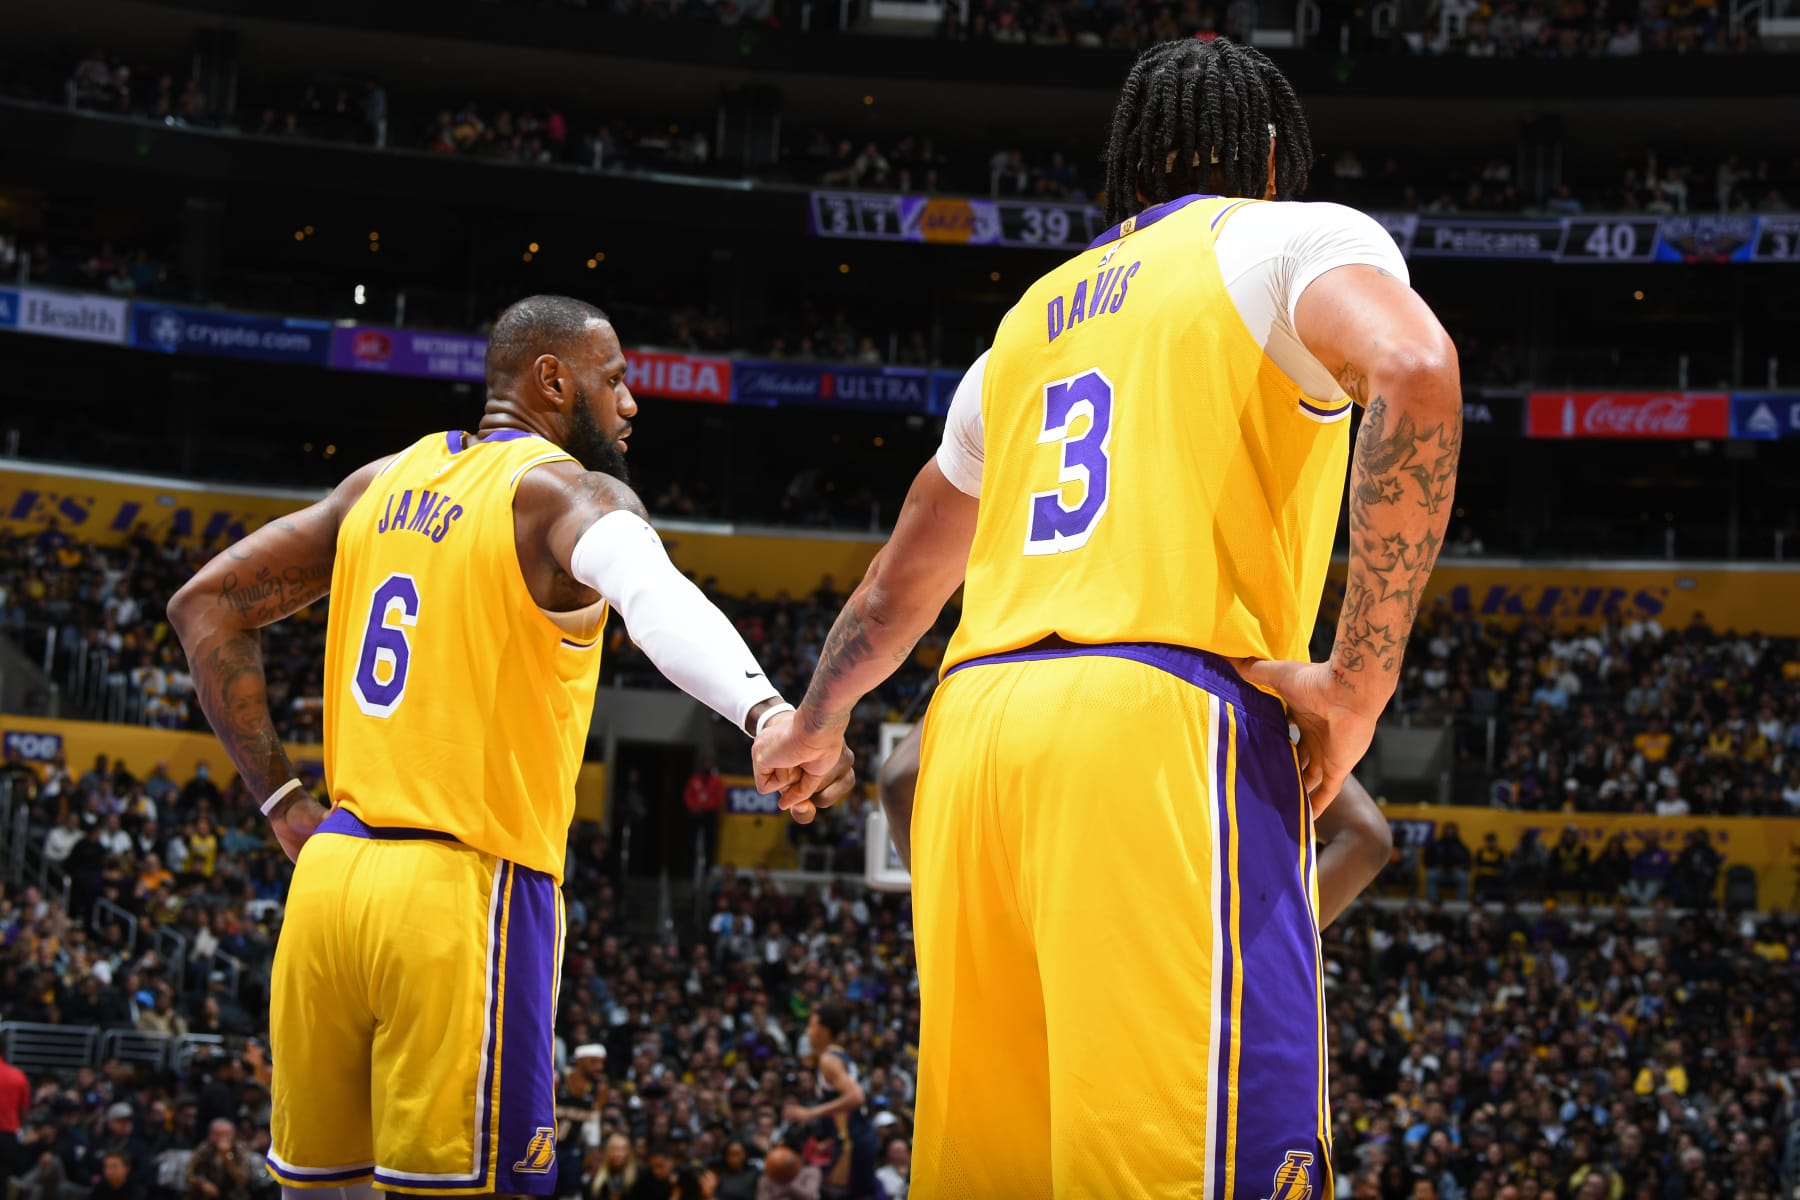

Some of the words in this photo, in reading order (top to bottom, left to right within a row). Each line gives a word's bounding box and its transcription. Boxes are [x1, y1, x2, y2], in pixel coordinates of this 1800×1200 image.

[1020, 207, 1071, 245] 39
[1433, 227, 1542, 252] Pelicans
[1584, 222, 1637, 261] 40
[27, 297, 117, 335] Health
[1047, 260, 1141, 343] DAVIS
[186, 321, 312, 353] crypto.com
[628, 359, 722, 395] HIBA
[835, 372, 922, 403] ULTRA
[1582, 396, 1696, 433] Coca-Cola
[1023, 366, 1115, 556] 3
[378, 488, 463, 543] JAMES
[1450, 584, 1670, 619] AKERS
[350, 571, 421, 720] 6
